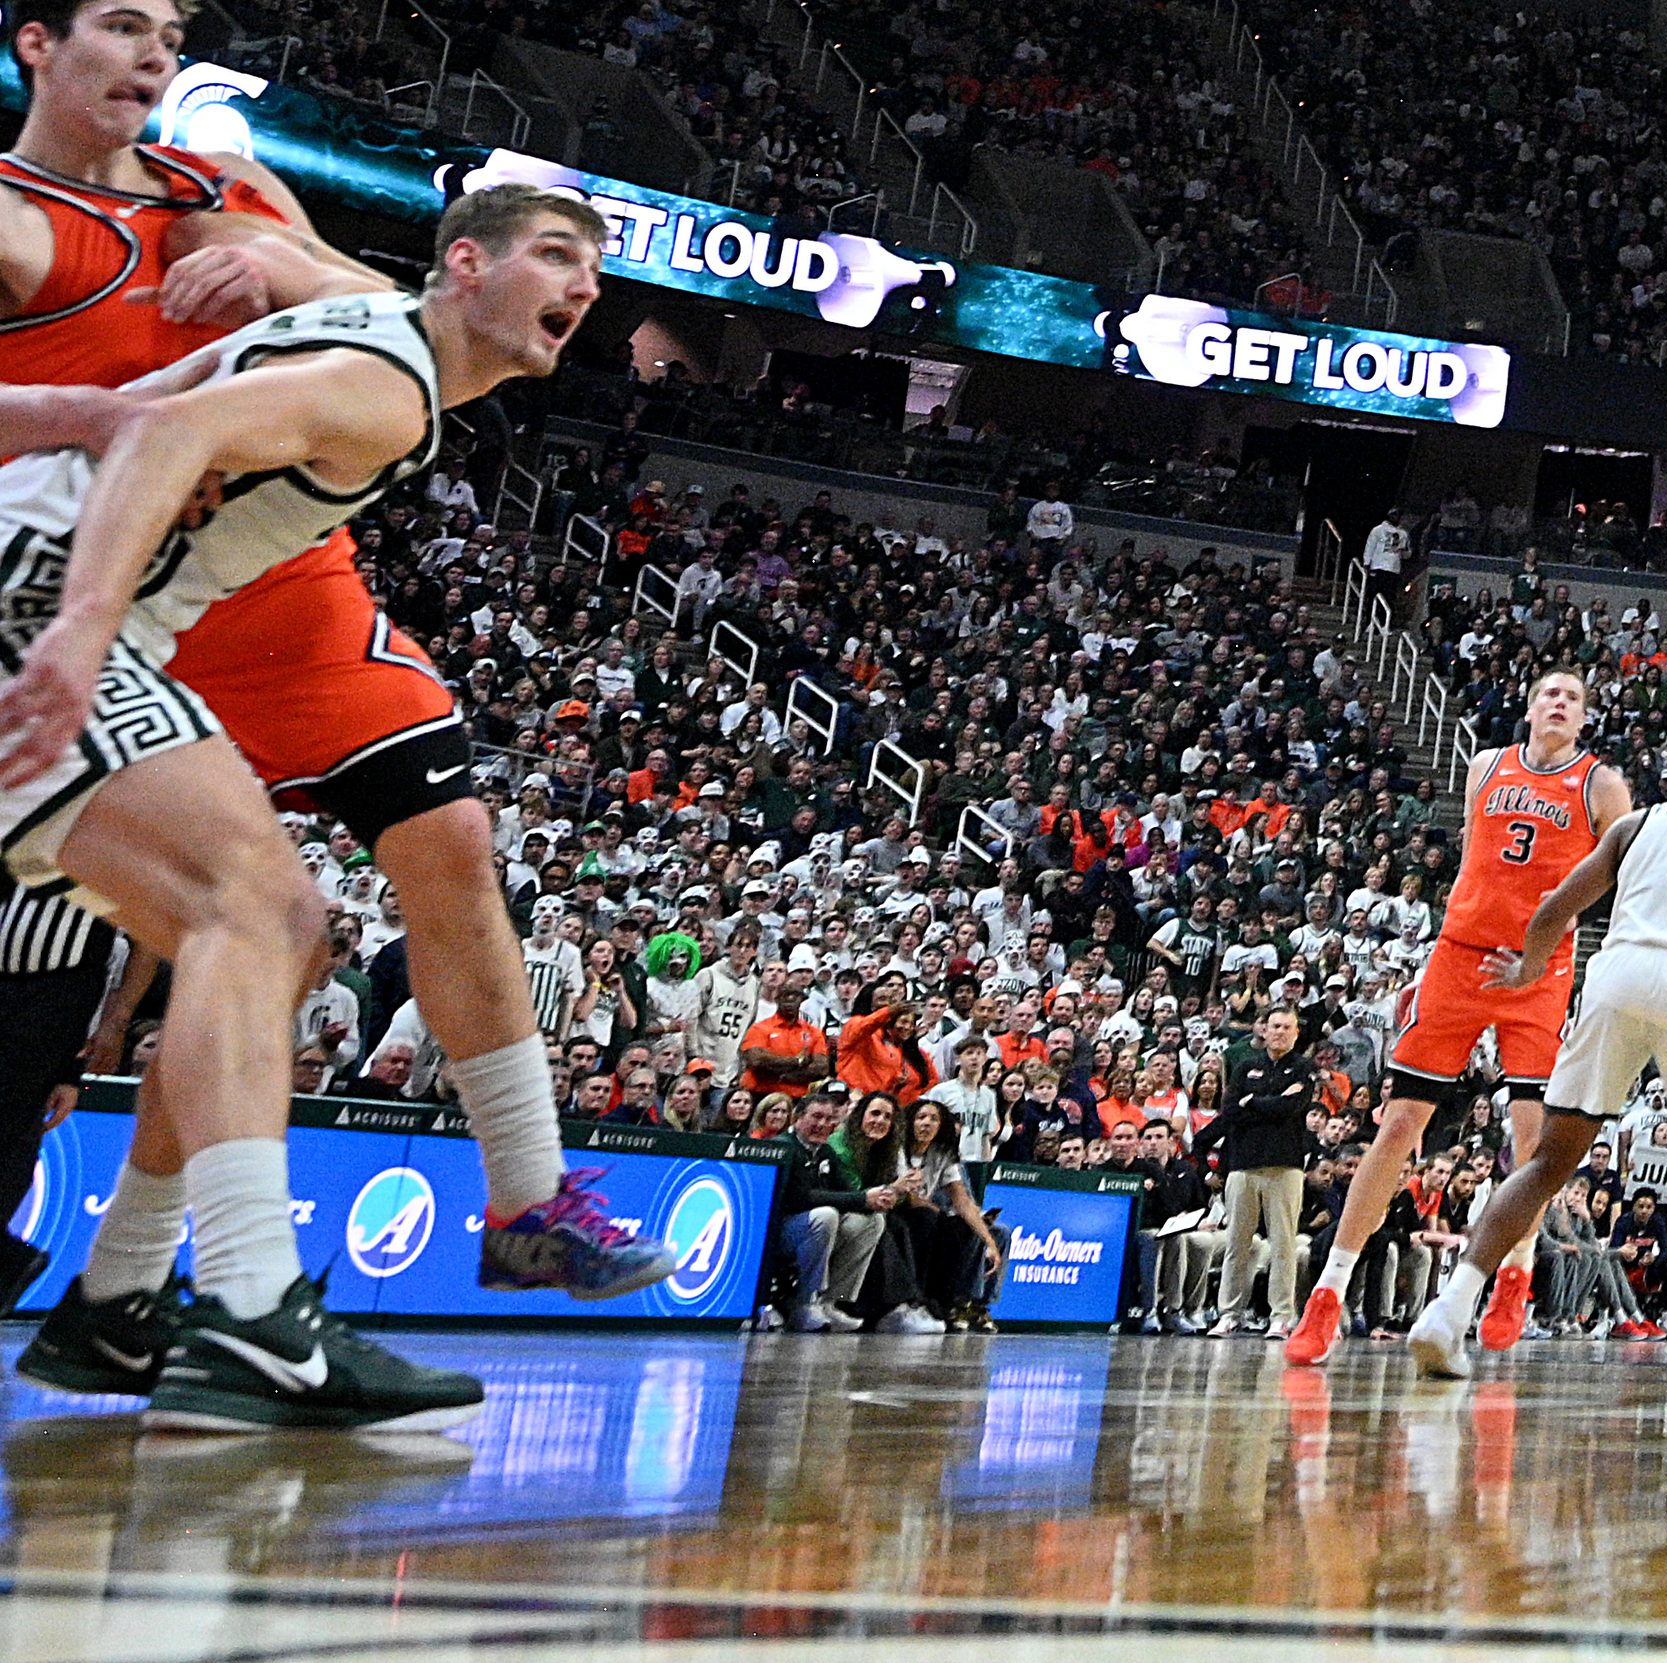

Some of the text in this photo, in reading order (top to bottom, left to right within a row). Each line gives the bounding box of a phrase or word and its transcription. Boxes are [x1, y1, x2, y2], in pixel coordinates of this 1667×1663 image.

[670, 214, 839, 293] LOUD
[1185, 322, 1467, 400] GET LOUD
[1484, 785, 1572, 831] Illinois
[1500, 820, 1538, 866] 3
[1184, 956, 1201, 976] 10
[719, 1012, 743, 1040] 55
[353, 1110, 415, 1129] ACRISURE
[602, 1133, 654, 1149] ACRISURE
[1013, 1265, 1080, 1285] INSURANCE
